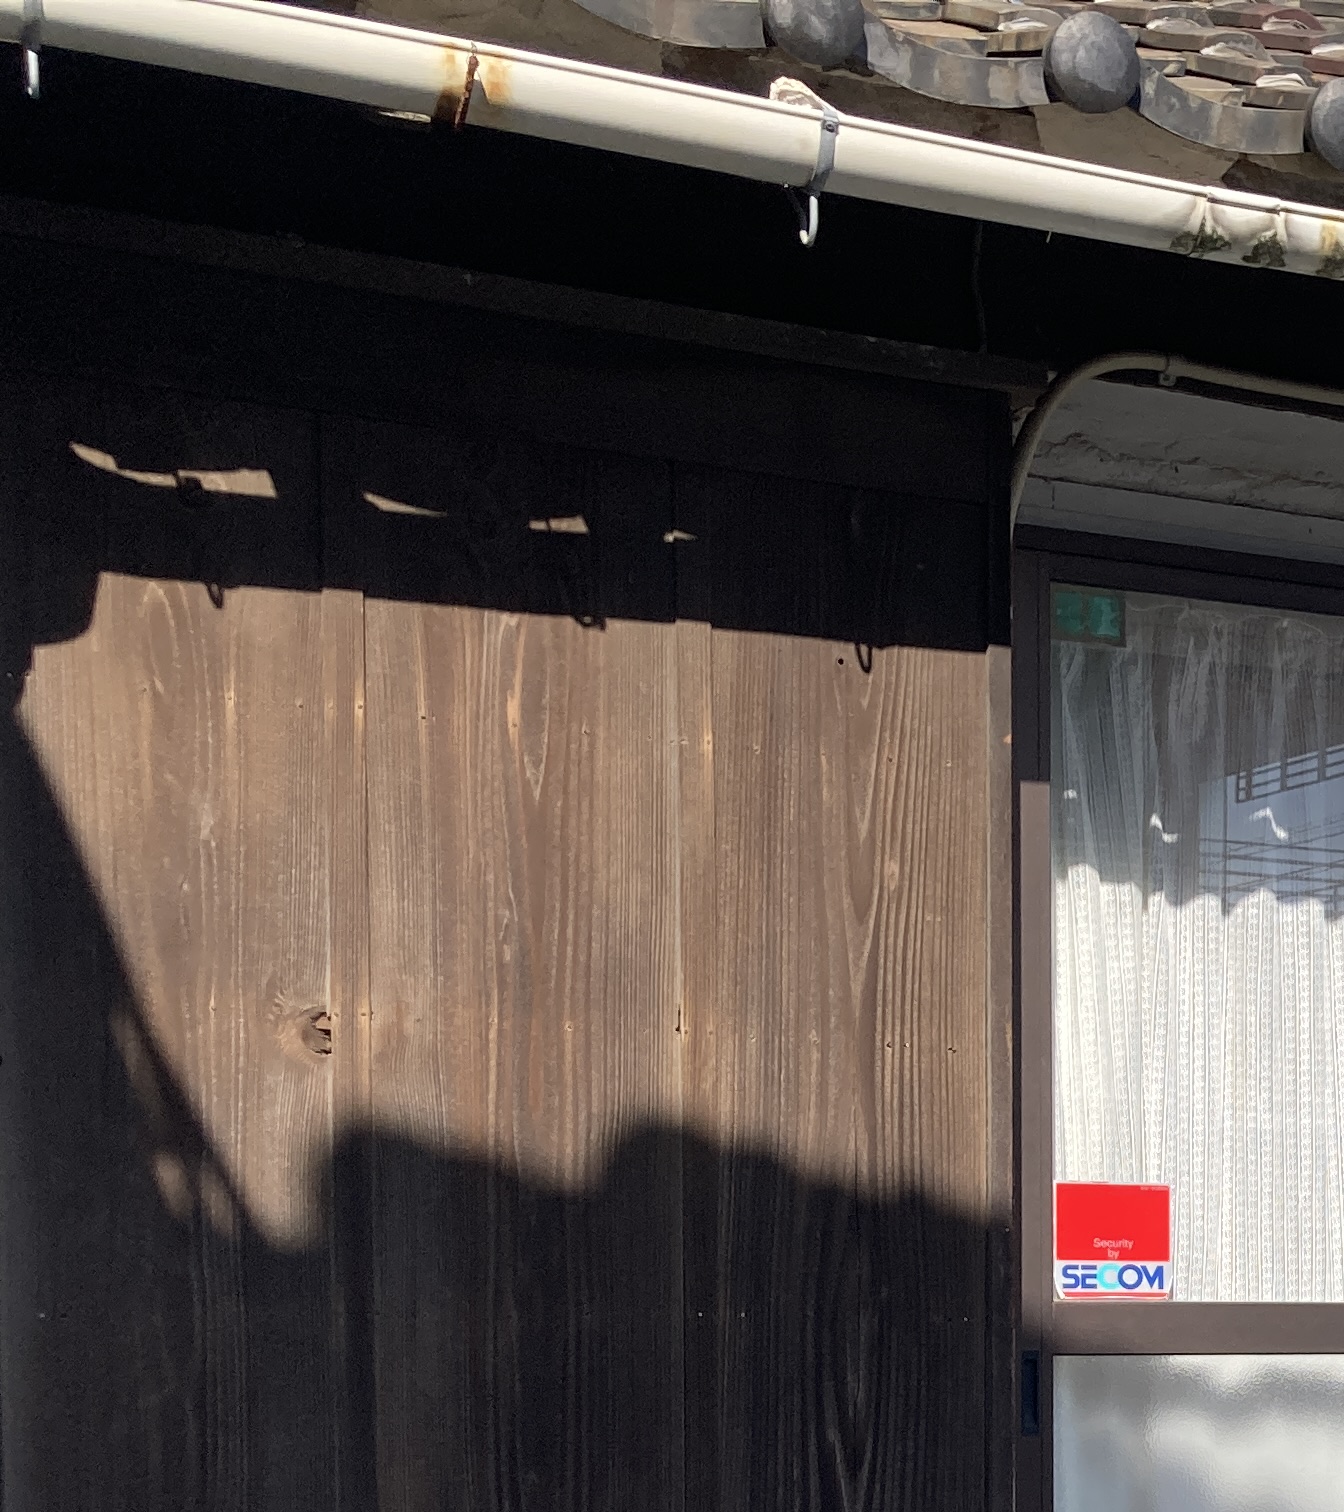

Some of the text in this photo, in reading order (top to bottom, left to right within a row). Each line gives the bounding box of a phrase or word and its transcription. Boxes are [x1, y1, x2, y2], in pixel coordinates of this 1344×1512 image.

[1093, 1237, 1134, 1250] Security
[1107, 1248, 1120, 1260] by
[1061, 1262, 1165, 1290] SECOM
